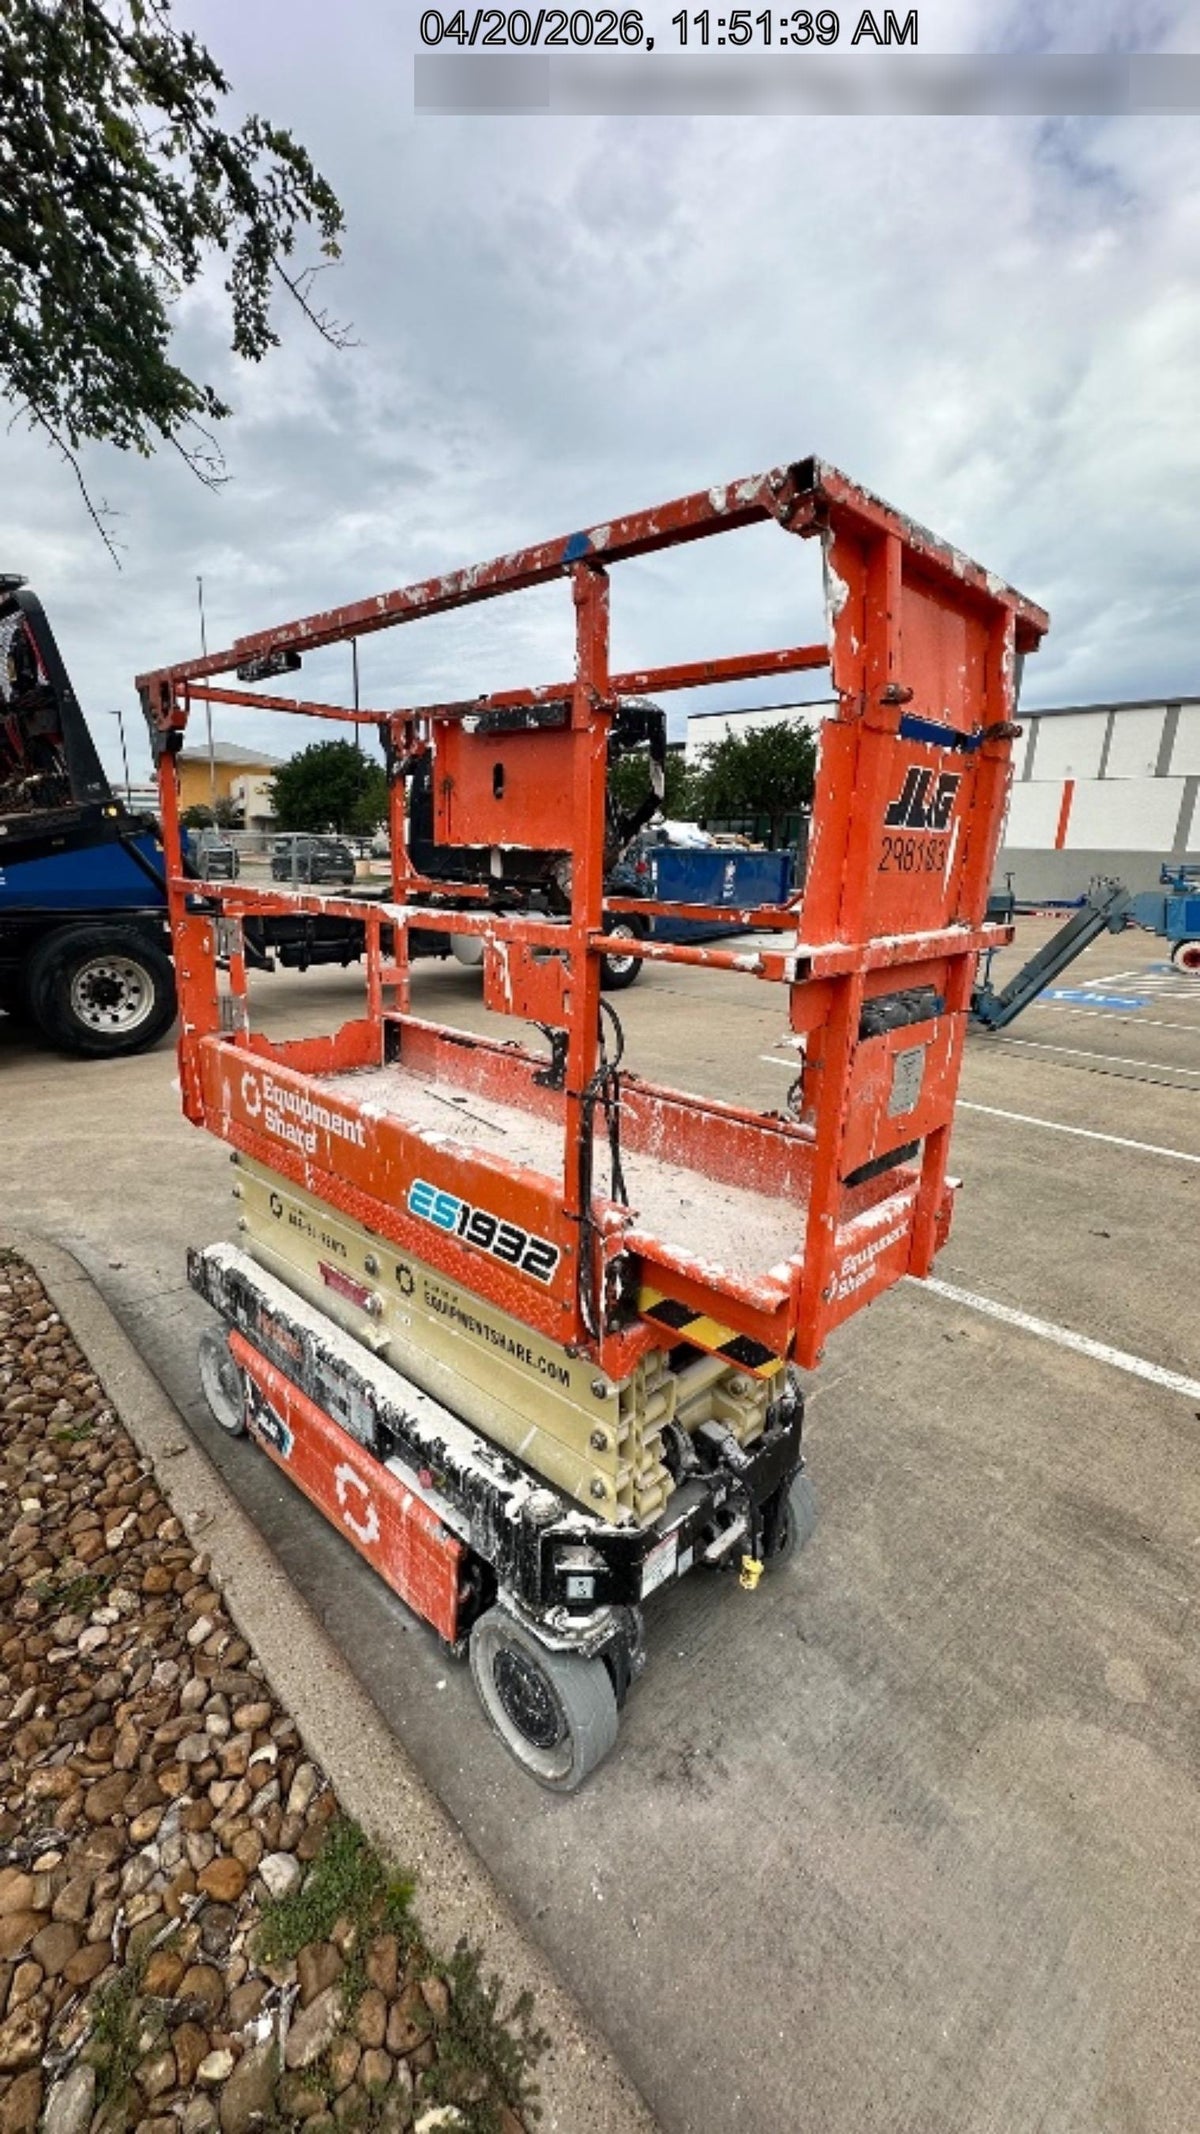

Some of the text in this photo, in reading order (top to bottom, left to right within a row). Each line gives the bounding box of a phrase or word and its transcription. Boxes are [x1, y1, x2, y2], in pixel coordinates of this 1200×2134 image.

[883, 764, 963, 833] JLG
[262, 1073, 366, 1149] Equipment
[408, 1178, 561, 1286] ES1932
[423, 1290, 571, 1388] EQUIPMENTSHARE.COM
